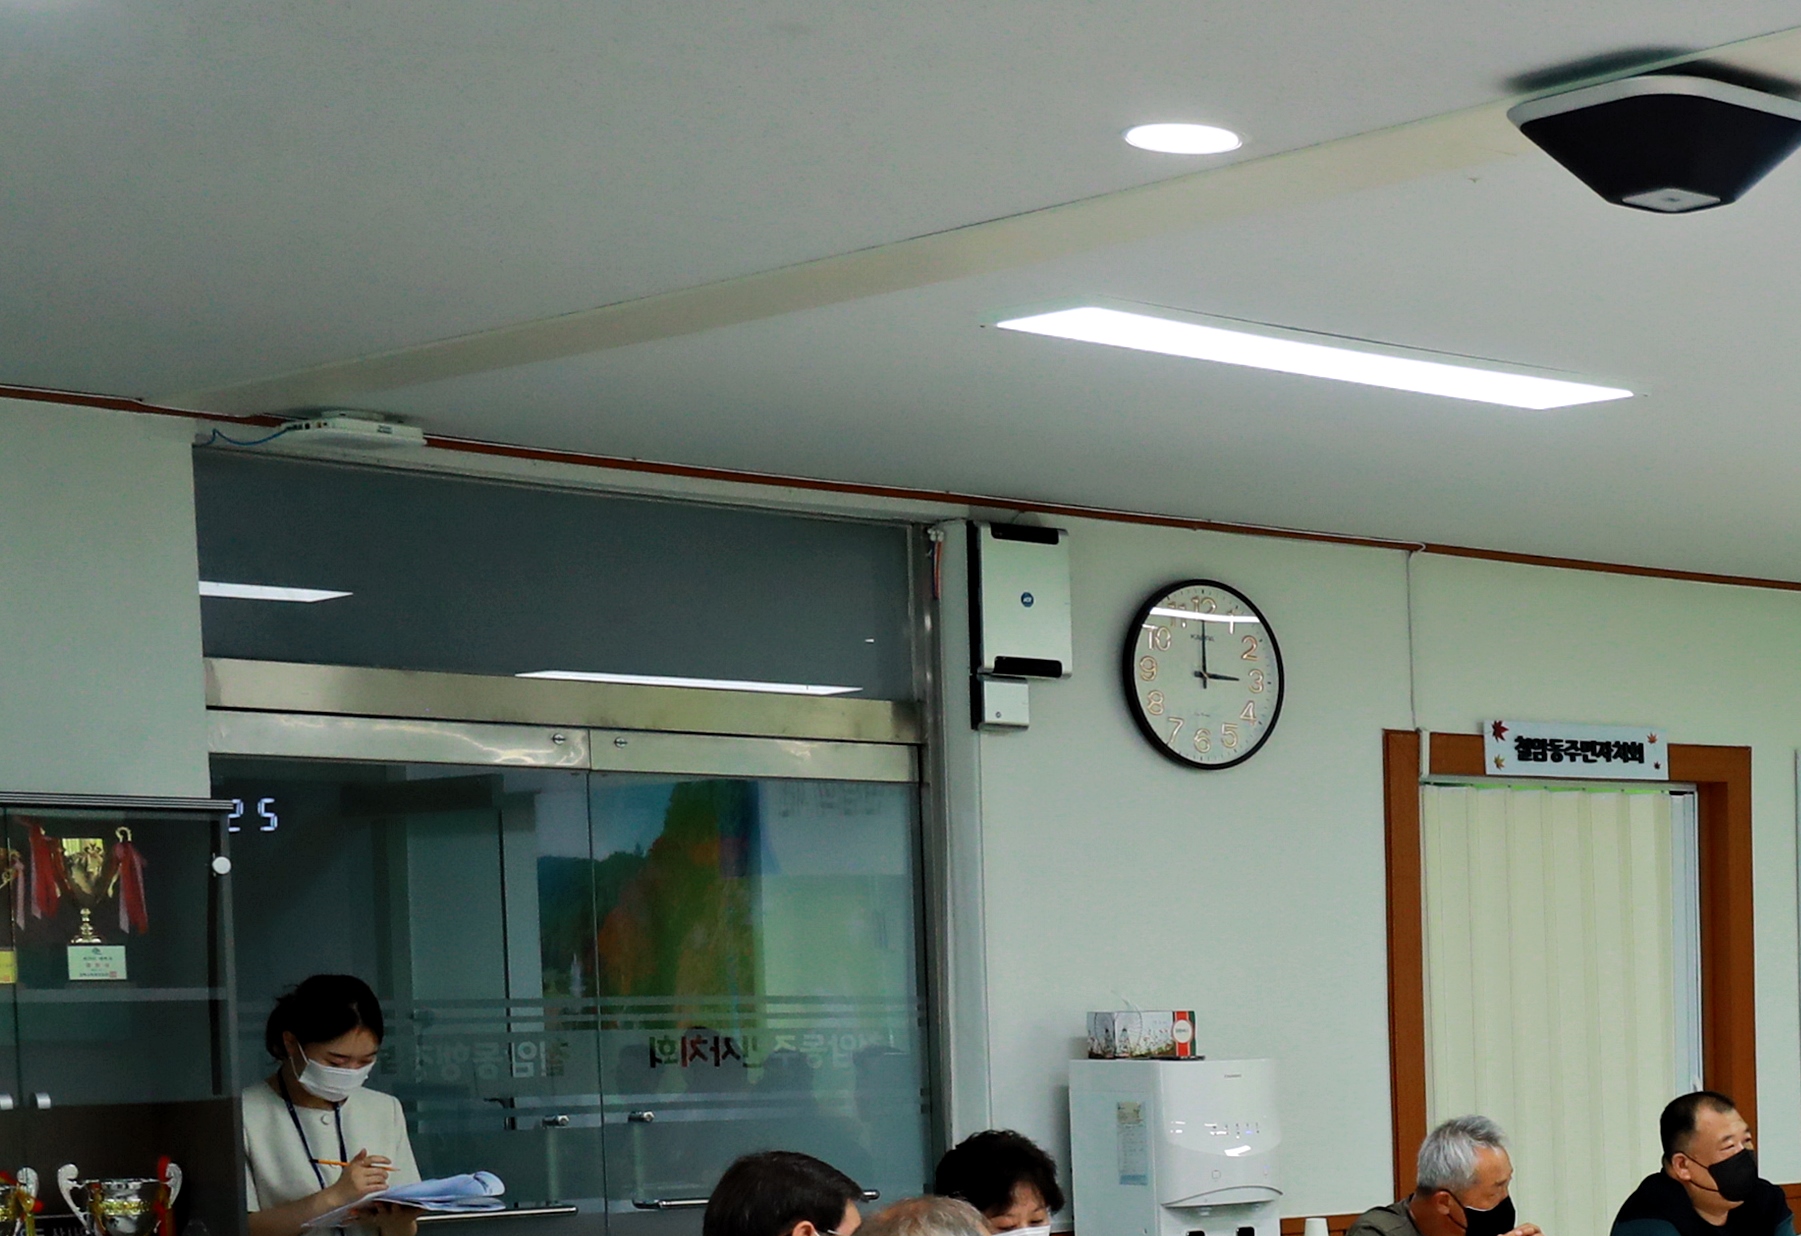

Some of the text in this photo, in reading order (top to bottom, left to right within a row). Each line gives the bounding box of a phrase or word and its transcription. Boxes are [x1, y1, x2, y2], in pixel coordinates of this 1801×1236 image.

[1191, 596, 1217, 622] 12
[1148, 625, 1171, 651] 10
[1241, 635, 1258, 661] 2
[1139, 655, 1157, 681] 9
[1248, 669, 1264, 693] 3
[1147, 690, 1164, 715] 8
[1240, 701, 1257, 725] 4
[1168, 717, 1184, 745] 7
[1193, 728, 1211, 753] 6
[1221, 723, 1238, 748] 5
[1514, 735, 1645, 764] 철암동주민자치회
